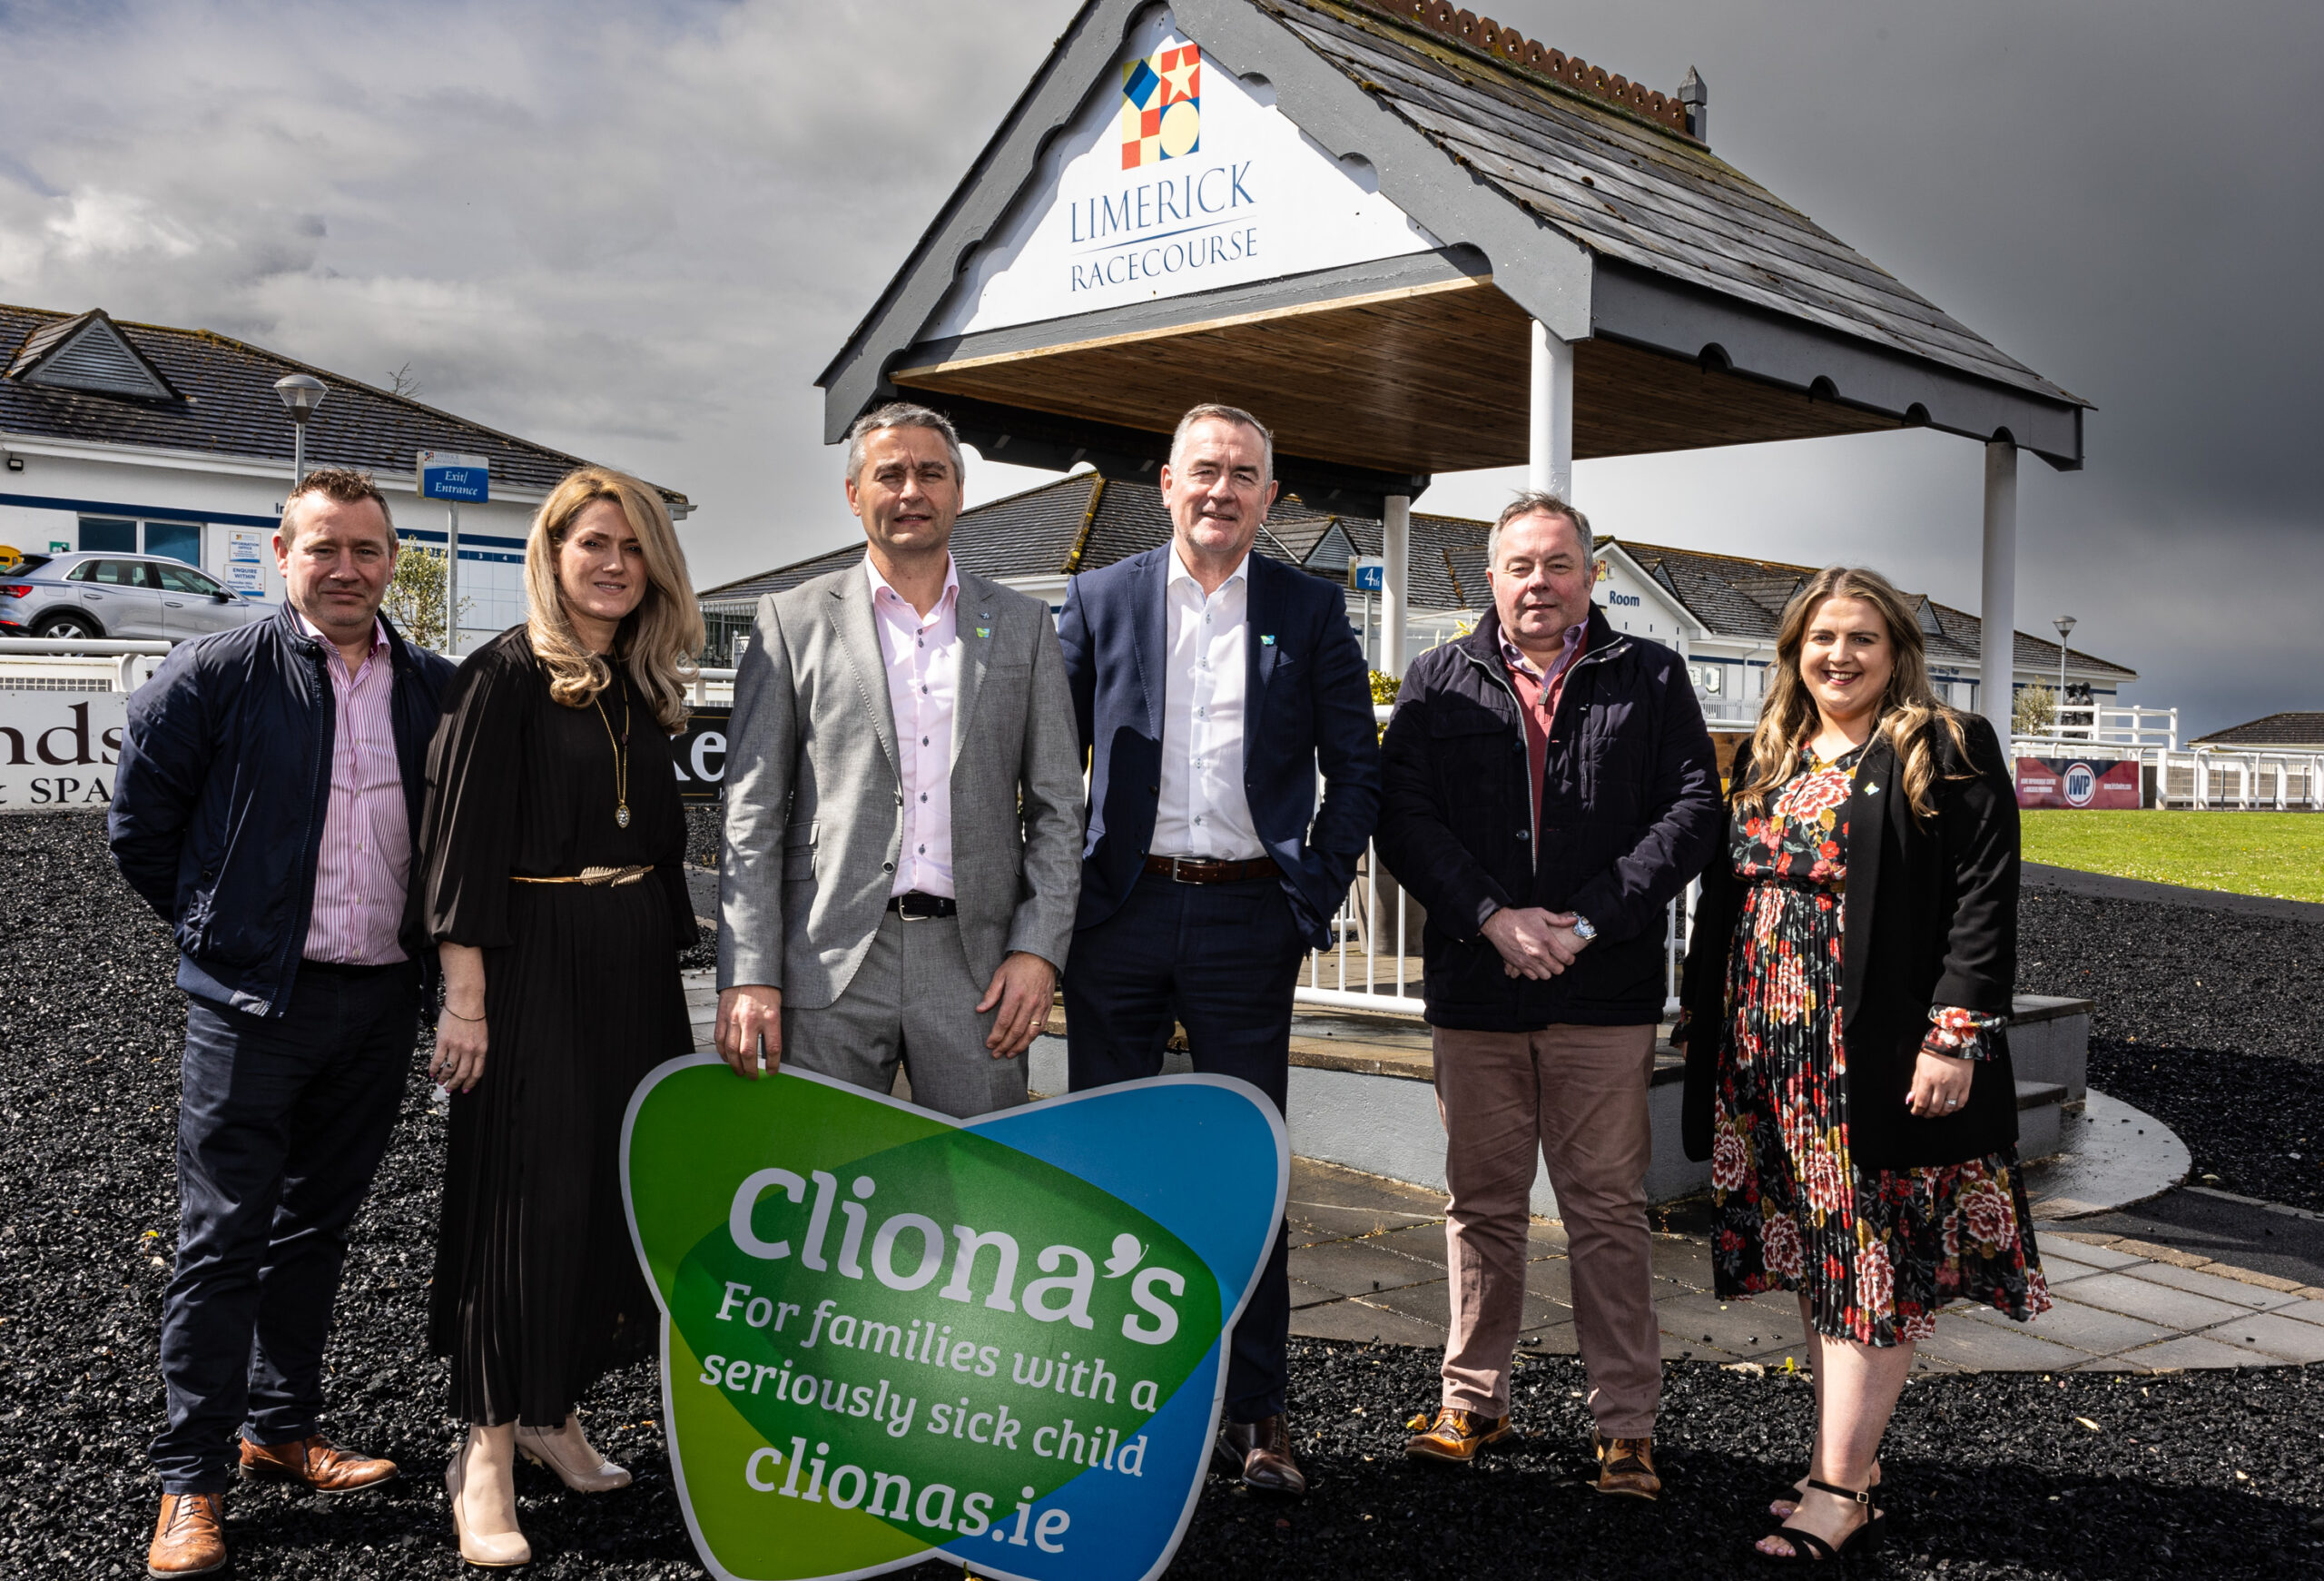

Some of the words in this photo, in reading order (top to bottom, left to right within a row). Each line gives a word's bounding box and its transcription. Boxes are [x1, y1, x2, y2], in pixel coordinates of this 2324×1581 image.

[1069, 160, 1256, 243] LIMERICK
[1071, 227, 1258, 292] RACECOURSE
[435, 481, 478, 496] Entrance
[445, 470, 468, 483] Exit/
[502, 554, 508, 562] 4
[1364, 568, 1380, 587] 4th
[1610, 590, 1640, 607] Room
[30, 777, 113, 805] SPA
[2068, 775, 2090, 795] IWP
[729, 1168, 1186, 1345] Cliona's
[715, 1282, 799, 1333] For
[801, 1299, 1000, 1378] families
[1012, 1350, 1115, 1401] with
[1130, 1380, 1159, 1414] a
[699, 1354, 919, 1438] seriously
[926, 1400, 1023, 1450] sick
[1032, 1418, 1147, 1478] child
[744, 1437, 1071, 1555] clionas.ie
